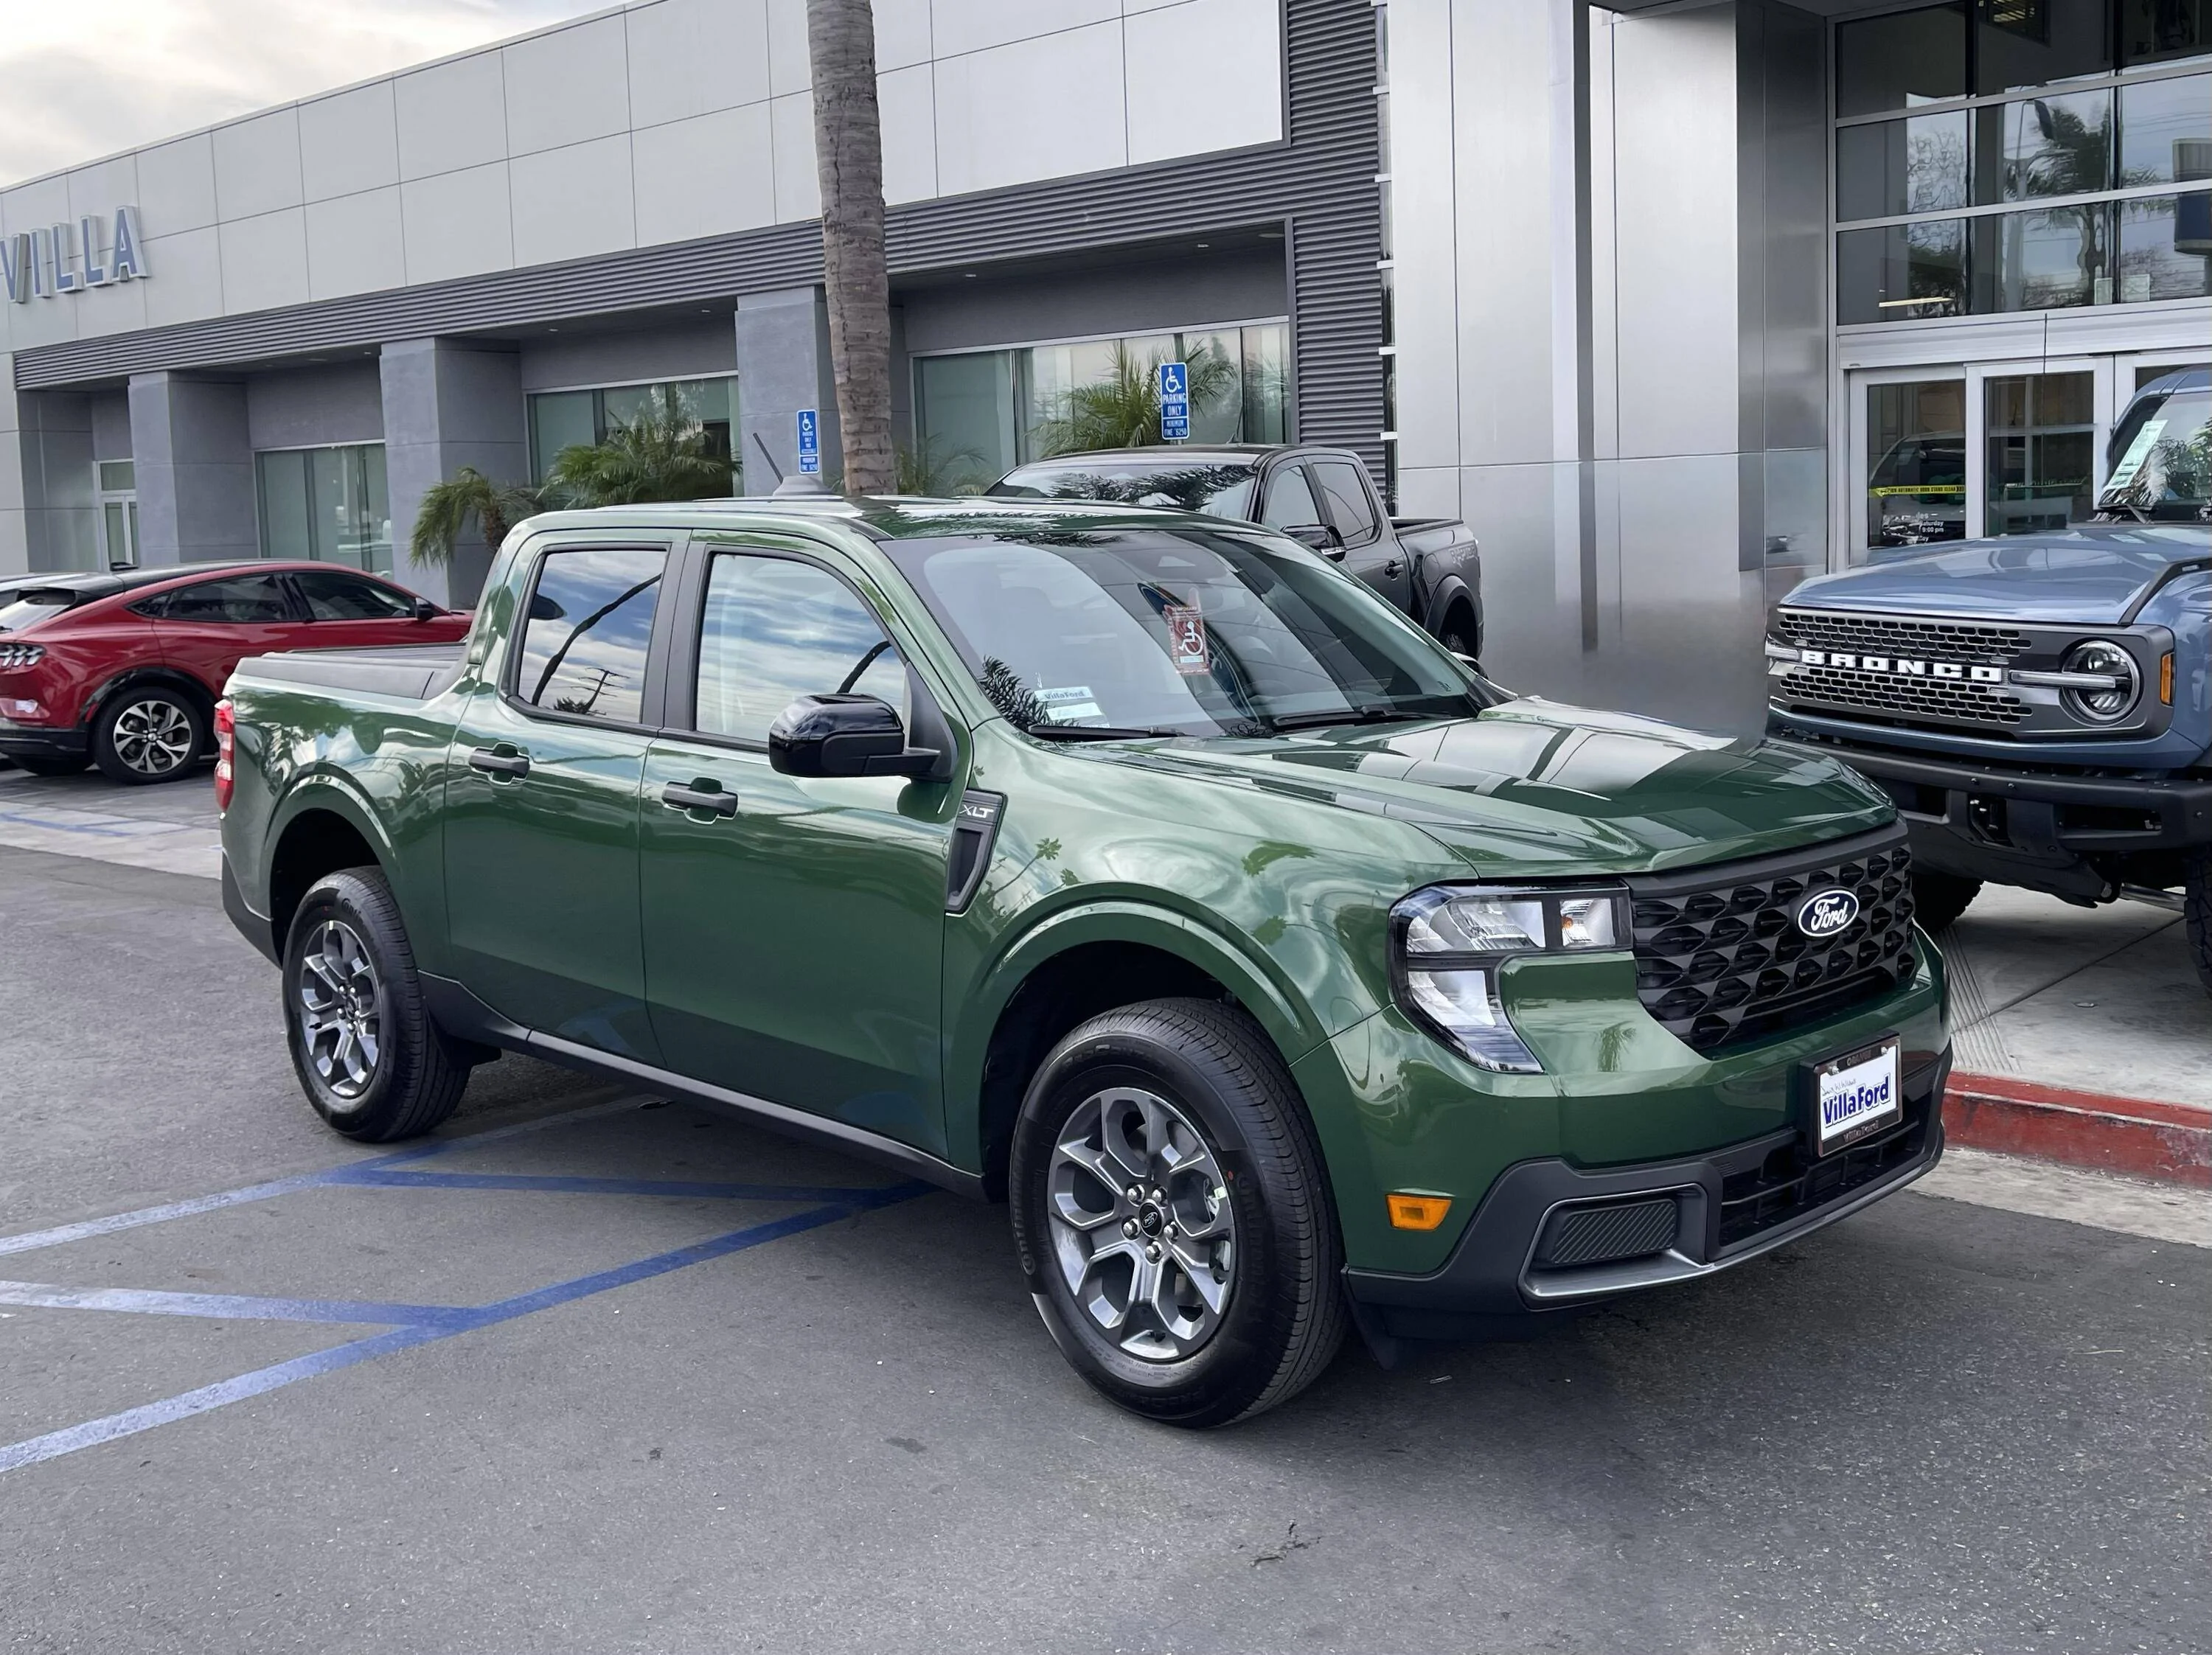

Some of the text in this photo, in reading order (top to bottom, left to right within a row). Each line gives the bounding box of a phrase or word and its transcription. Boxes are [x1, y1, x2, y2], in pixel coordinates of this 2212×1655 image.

[0, 205, 150, 304] VILLA
[1163, 393, 1186, 405] PARKING
[1167, 405, 1183, 417] ONLY
[1164, 428, 1173, 436] FINE
[1802, 650, 2003, 683] BRONCO
[959, 804, 994, 819] XLT
[1811, 896, 1848, 931] Ford
[1823, 1074, 1890, 1125] VillaFord
